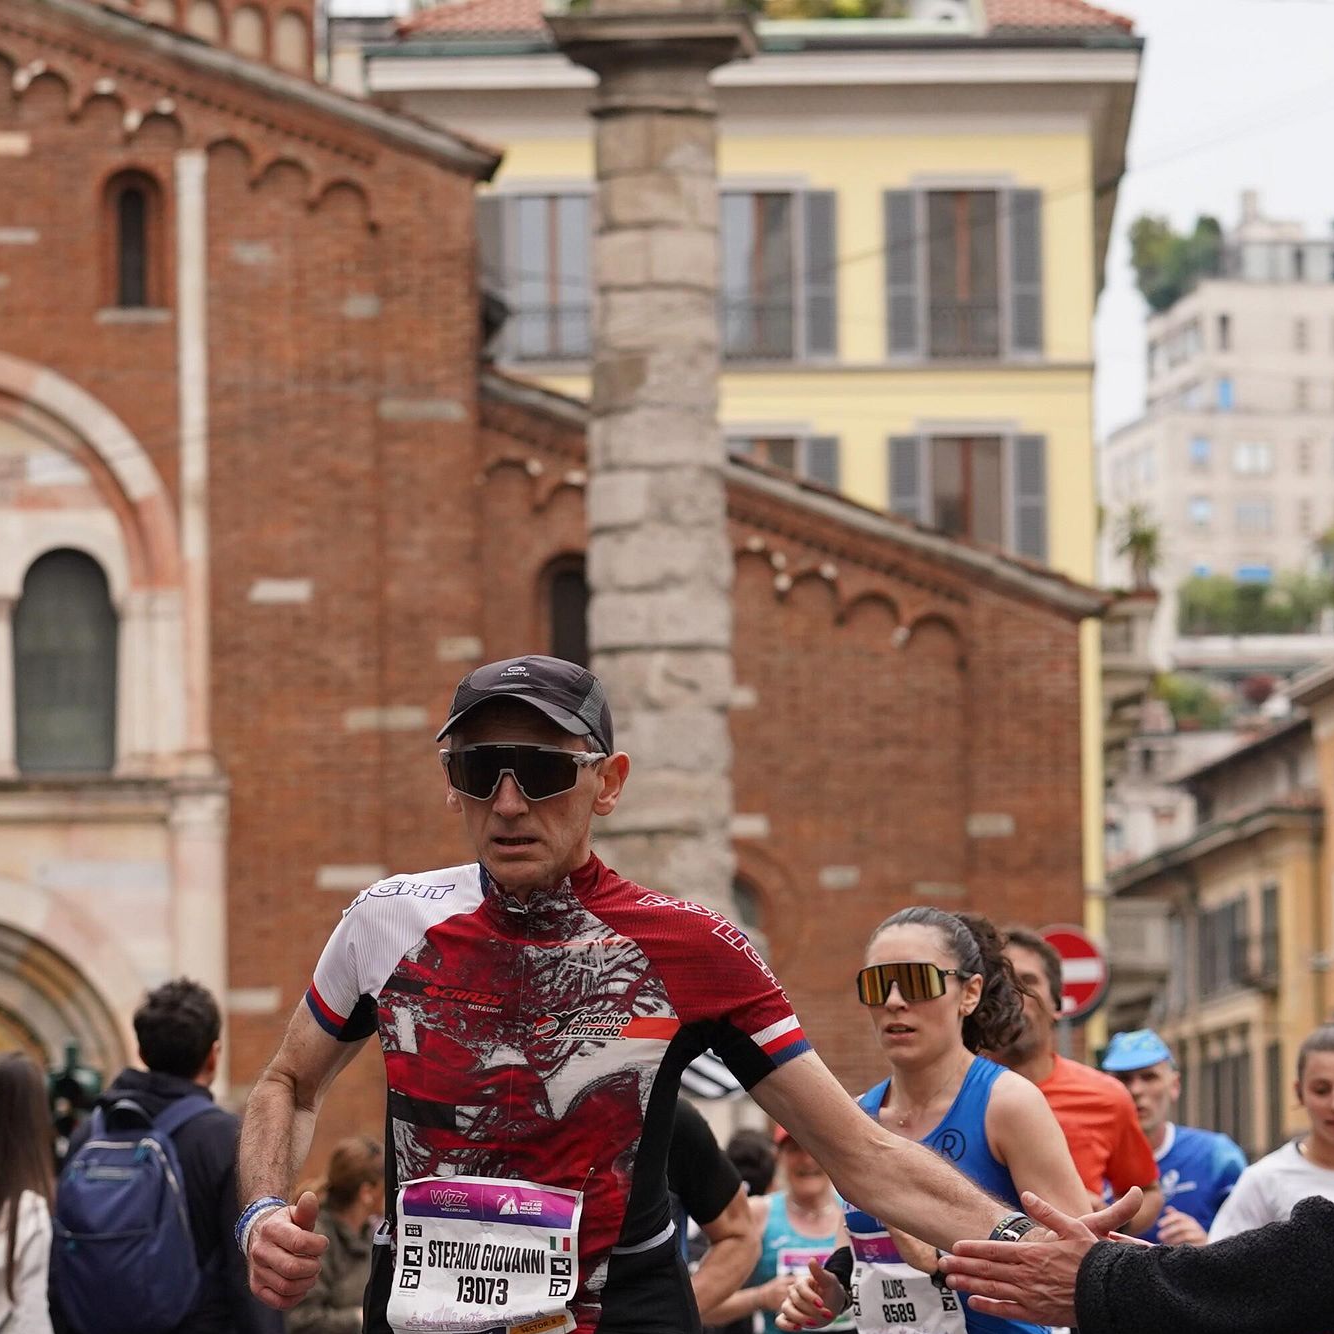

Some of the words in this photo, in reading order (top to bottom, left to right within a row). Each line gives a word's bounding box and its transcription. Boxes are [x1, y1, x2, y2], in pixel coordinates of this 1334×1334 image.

[440, 988, 505, 1005] CRAZY
[575, 1011, 631, 1027] Sportiva
[565, 1024, 621, 1037] Lanzada
[428, 1239, 481, 1271] STEFANO
[481, 1243, 546, 1275] GIOVANNI
[456, 1275, 509, 1306] 13073
[881, 1279, 908, 1299] ALICE
[882, 1302, 917, 1324] 8589
